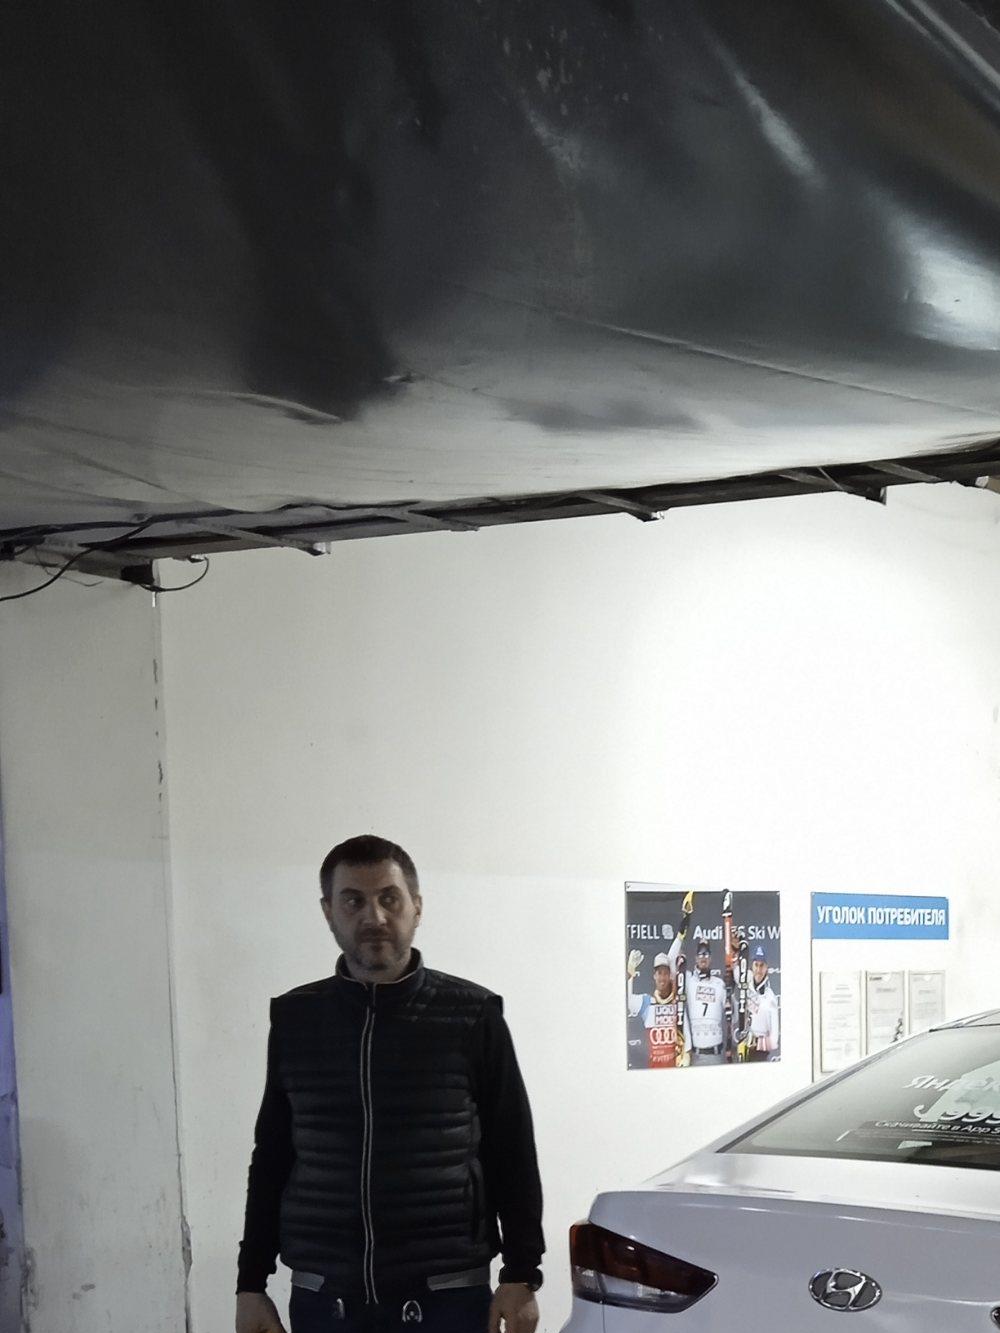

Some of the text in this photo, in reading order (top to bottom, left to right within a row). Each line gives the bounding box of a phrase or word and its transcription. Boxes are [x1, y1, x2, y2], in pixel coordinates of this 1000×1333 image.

[817, 906, 946, 926] УГОЛОК ПОТРЕБИТЕЛЯ
[693, 925, 723, 940] Audi
[748, 925, 766, 940] Ski
[702, 1002, 709, 1017] 7
[961, 1124, 989, 1135] App
